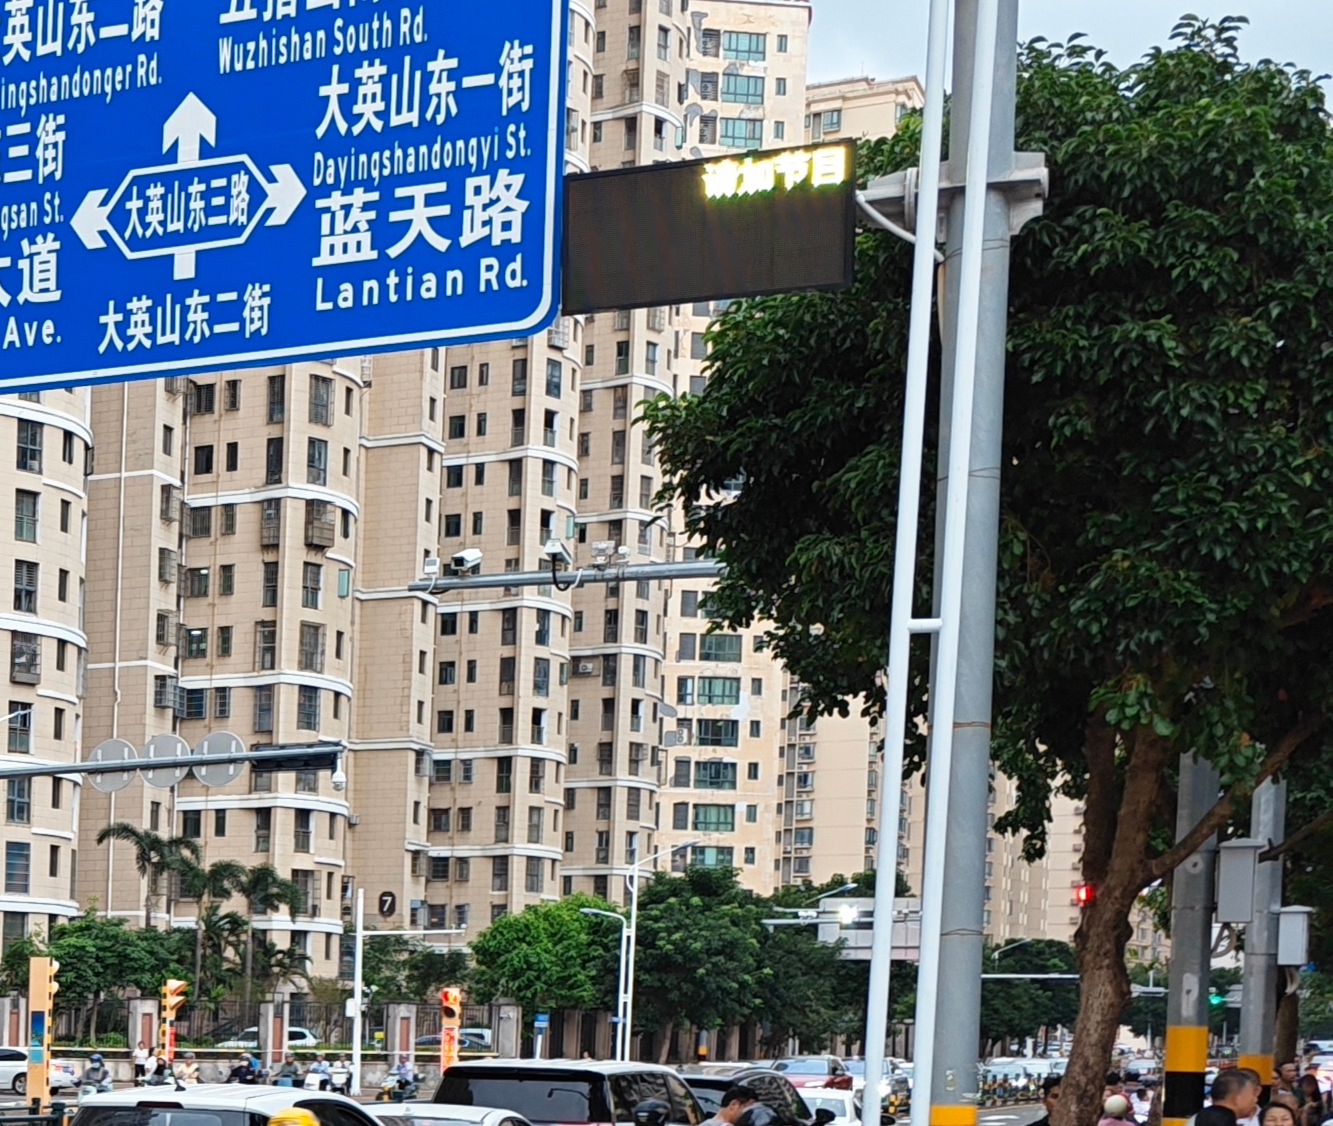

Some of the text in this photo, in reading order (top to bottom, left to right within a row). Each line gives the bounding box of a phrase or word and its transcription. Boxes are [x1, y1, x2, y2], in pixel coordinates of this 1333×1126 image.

[137, 52, 163, 88] Rd.
[219, 25, 326, 74] Wuzhishan
[333, 11, 392, 56] South
[399, 5, 428, 46] Rd.
[315, 39, 534, 140] 大英山东一街
[313, 122, 532, 188] Dayingshandongyi St.
[43, 191, 65, 226] St.
[124, 170, 250, 241] 大英山东三路
[311, 169, 530, 268] 蓝天路
[315, 253, 530, 312] Lantian Rd.
[2, 315, 62, 350] Ave.
[97, 283, 271, 355] 大英山东二街
[382, 896, 393, 912] 7
